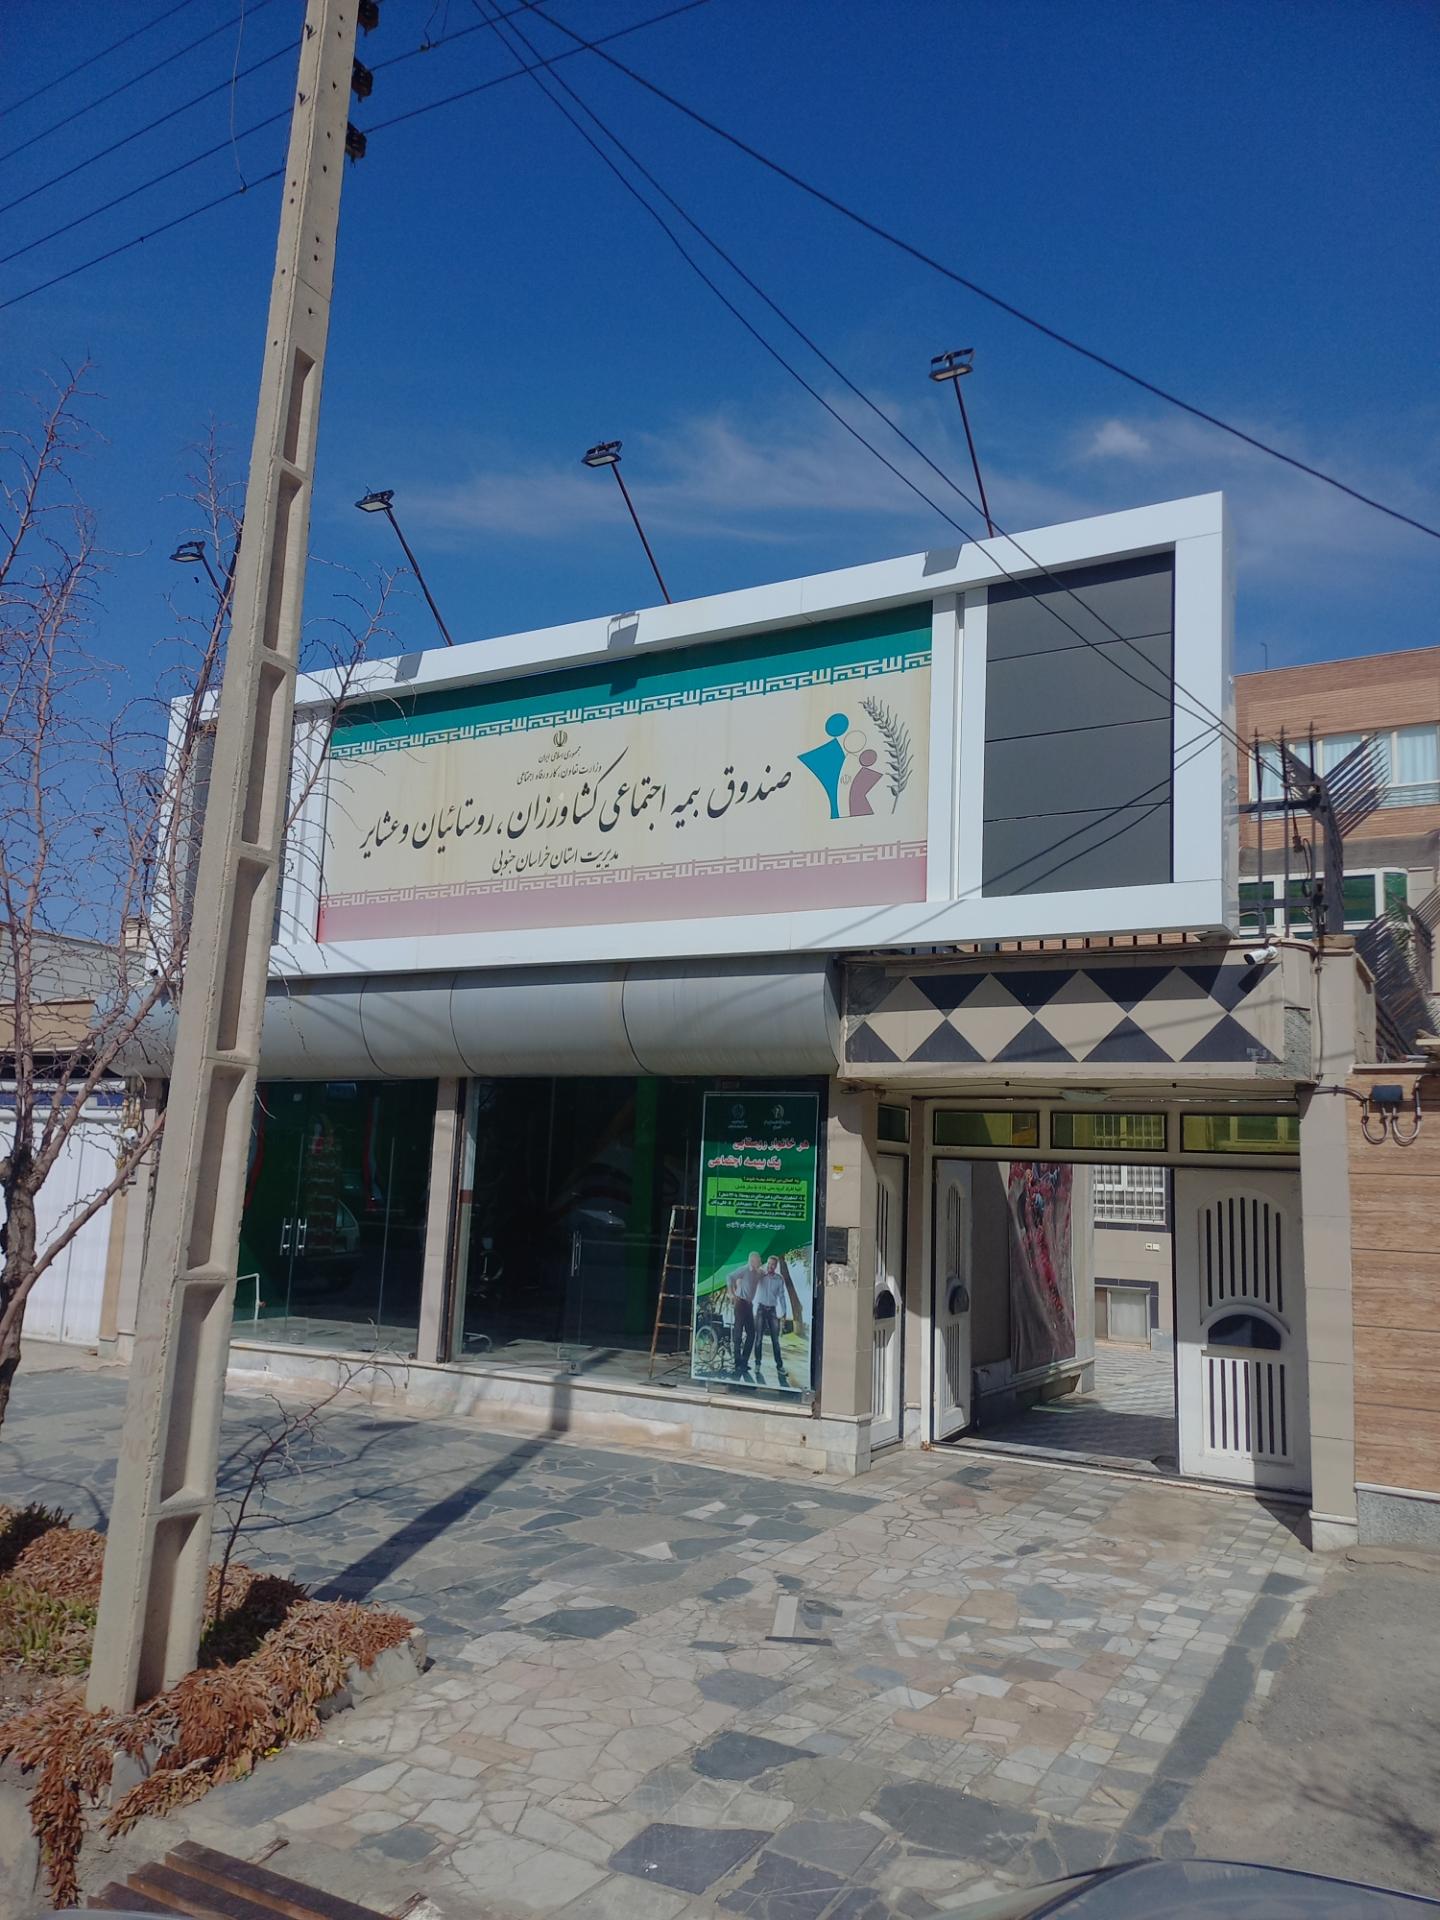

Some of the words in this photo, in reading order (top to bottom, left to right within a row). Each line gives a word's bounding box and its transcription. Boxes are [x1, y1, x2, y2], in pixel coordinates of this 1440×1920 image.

[538, 753, 550, 763] ایران
[551, 751, 564, 762] اسلامی
[564, 745, 581, 760] جمهوری
[579, 761, 602, 775] وزارت
[517, 770, 534, 785] اجتماعی
[707, 765, 792, 819] صندوق
[599, 776, 666, 833] اجتماعی
[671, 785, 701, 829] بیمه
[412, 798, 495, 854] روستائیان
[359, 810, 398, 859] عشایر
[492, 849, 516, 876] جنوبی
[516, 845, 551, 872] خراسان
[550, 847, 578, 869] استان
[580, 847, 619, 869] مدیریت
[732, 1137, 767, 1151] روستایی
[768, 1137, 796, 1151] خانوار
[797, 1140, 809, 1151] هر
[708, 1154, 743, 1168] اجتماعی
[743, 1156, 766, 1170] بیمه
[767, 1156, 781, 1170] یک
